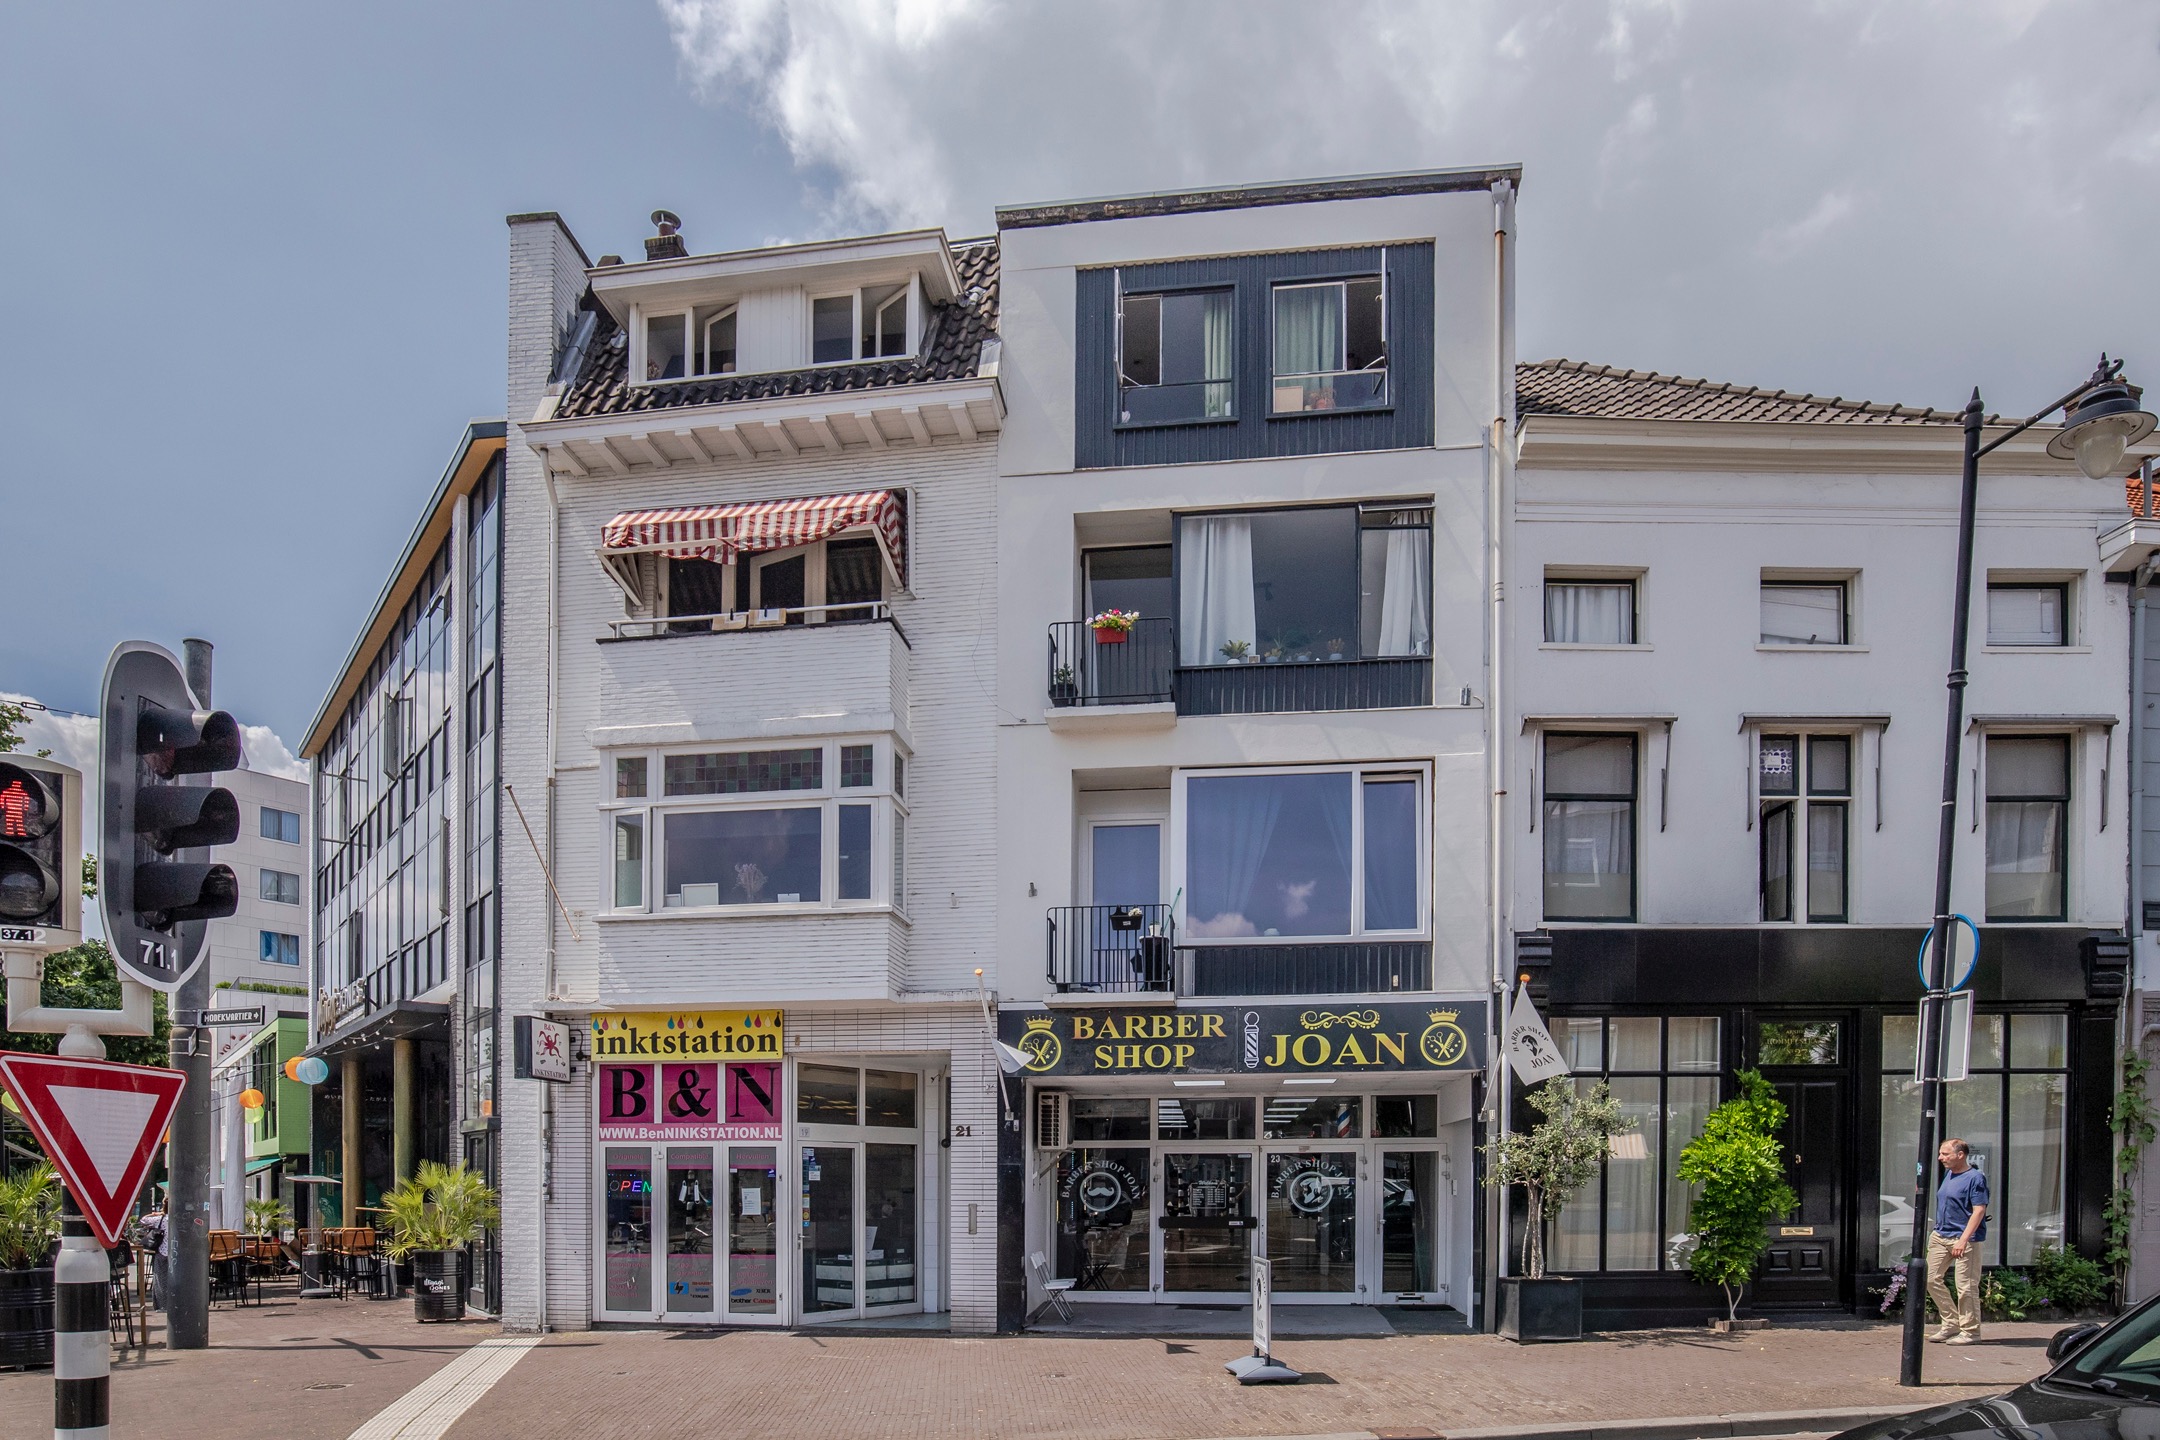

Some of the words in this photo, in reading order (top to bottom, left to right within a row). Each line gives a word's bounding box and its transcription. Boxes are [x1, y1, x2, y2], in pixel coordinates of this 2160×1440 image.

[2, 929, 32, 940] 37.1
[139, 939, 178, 972] 71.1
[204, 1011, 253, 1022] MODEKWARTIER
[1071, 1014, 1227, 1040] BARBER
[595, 1026, 778, 1055] inktstation
[1511, 1025, 1527, 1052] BARBER
[1527, 1025, 1549, 1042] SHOP
[1094, 1044, 1196, 1069] SHOP
[1264, 1032, 1409, 1067] JOAN
[1530, 1054, 1555, 1069] JOAN
[599, 1127, 782, 1139] WWW.BenNINKSTATION.NL
[801, 1128, 809, 1136] 19
[955, 1125, 972, 1137] 21
[1270, 1154, 1281, 1163] 23
[609, 1180, 653, 1193] OPEN
[1061, 1160, 1093, 1199] BARBER
[1095, 1160, 1125, 1173] SHOP
[1122, 1172, 1141, 1200] JOAN
[1271, 1160, 1303, 1199] BARBER
[1305, 1159, 1337, 1173] SHOP
